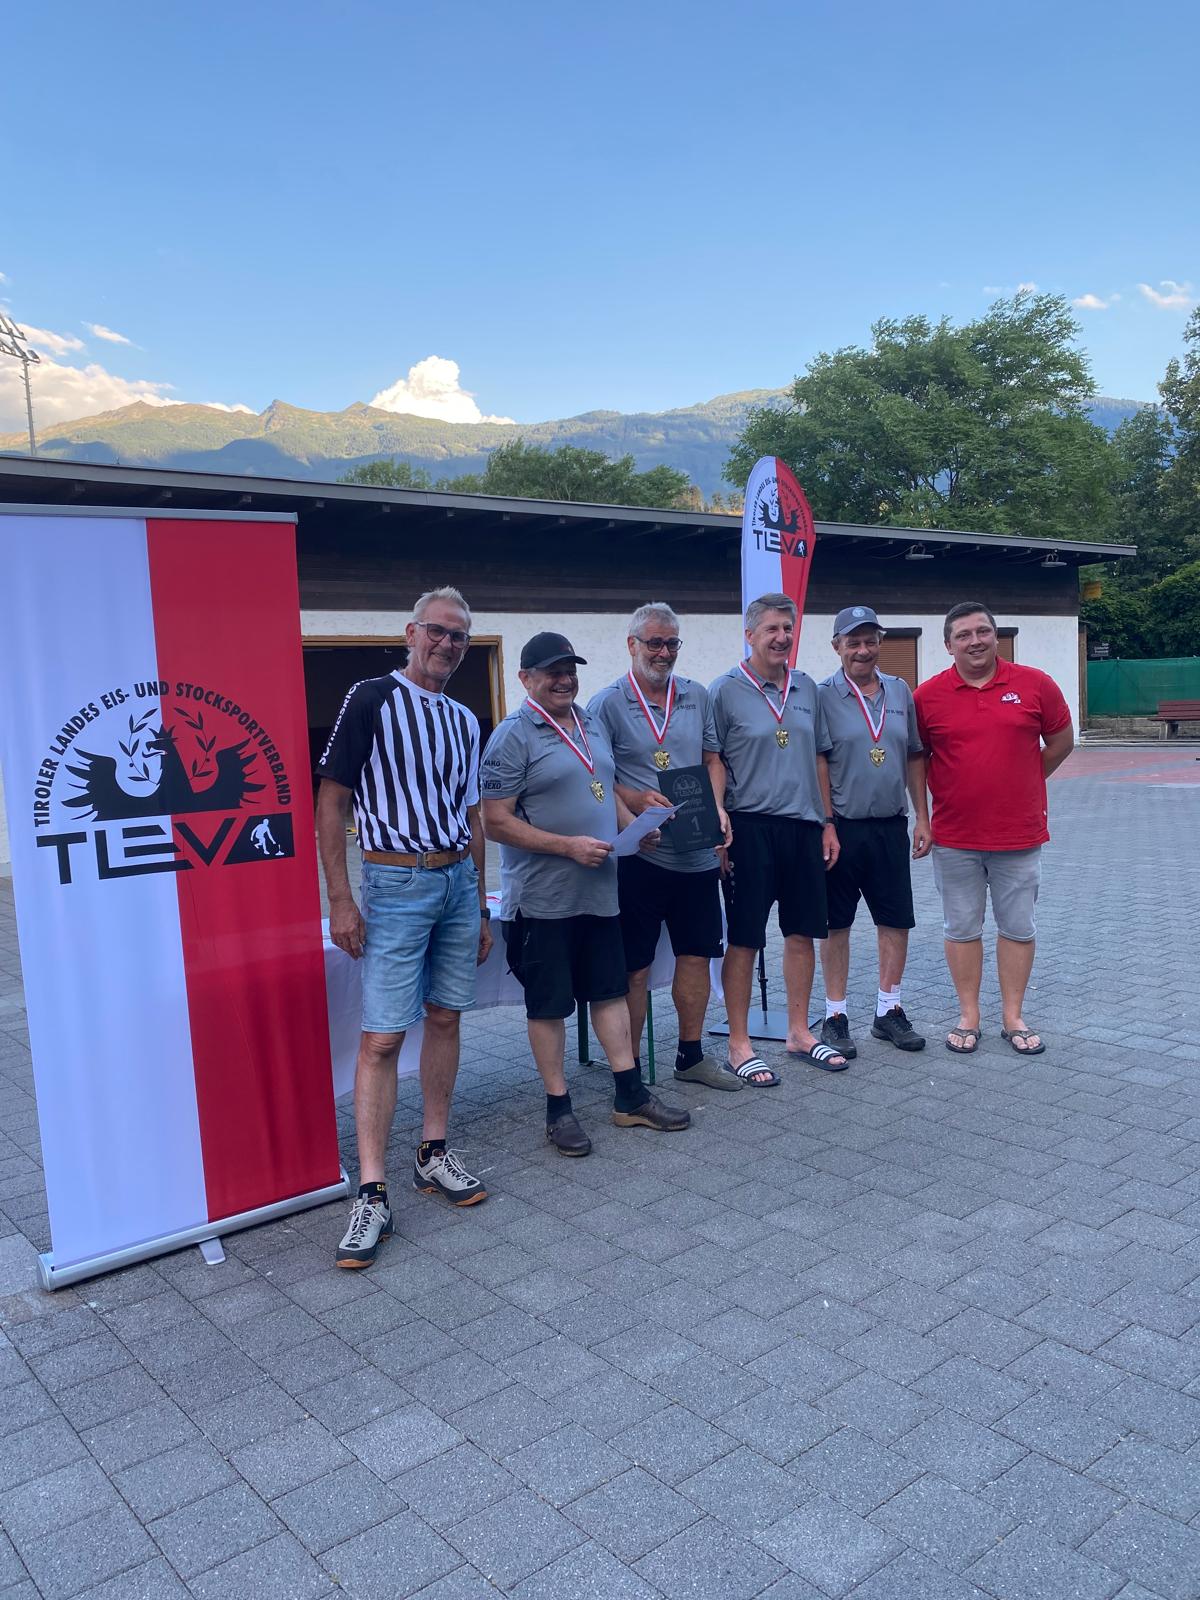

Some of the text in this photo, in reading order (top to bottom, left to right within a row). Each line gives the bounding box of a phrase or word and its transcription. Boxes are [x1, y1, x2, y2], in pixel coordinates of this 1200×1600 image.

[34, 680, 291, 828] TIROLER LANDES EIS- UND STOCKSPORTVERBAND
[691, 815, 700, 831] 1
